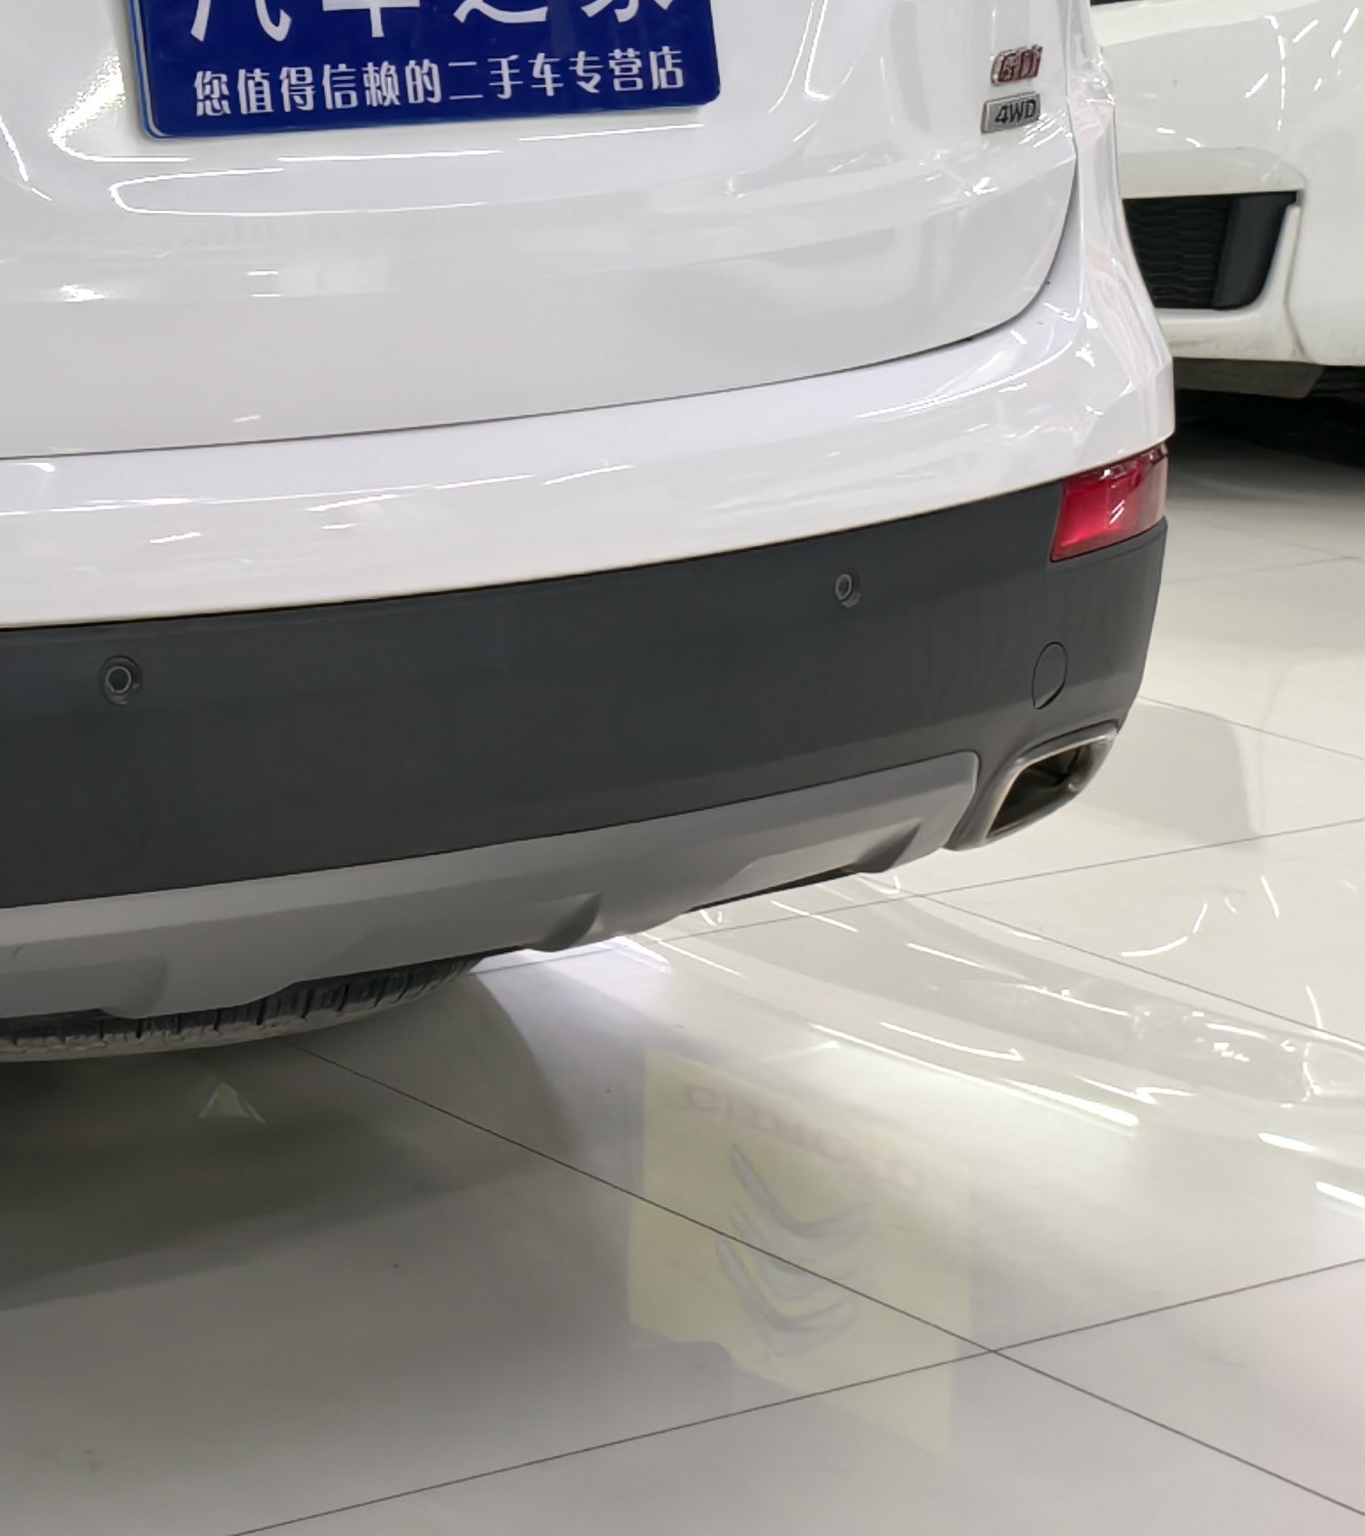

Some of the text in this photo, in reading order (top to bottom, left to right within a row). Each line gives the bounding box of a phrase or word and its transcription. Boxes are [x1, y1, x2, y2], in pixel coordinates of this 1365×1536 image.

[193, 45, 686, 118] 您值得信赖的二手车专营店
[995, 98, 1037, 124] 4WD
